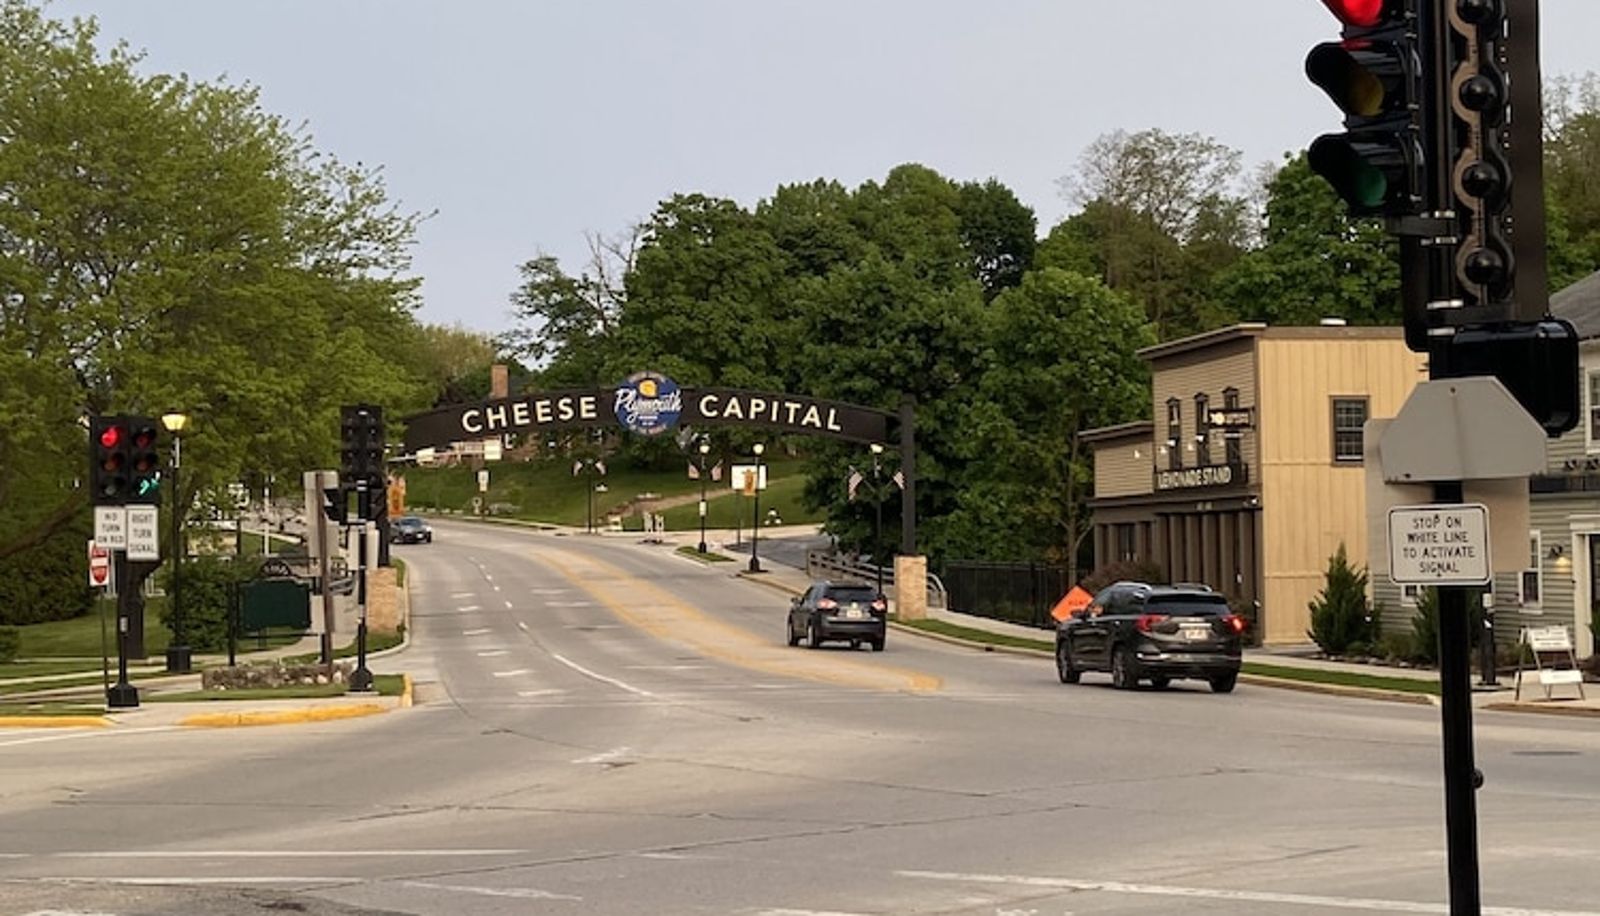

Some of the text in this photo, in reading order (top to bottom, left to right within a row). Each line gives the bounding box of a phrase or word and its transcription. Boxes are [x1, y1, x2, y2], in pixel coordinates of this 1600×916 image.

[461, 396, 597, 432] CHEESE
[699, 394, 842, 431] CAPITAL
[1412, 516, 1462, 529] STOP ON
[1407, 531, 1469, 543] WHITE LINE
[1402, 546, 1476, 558] TO ACTIVATE
[1419, 561, 1460, 573] SIGNAL
